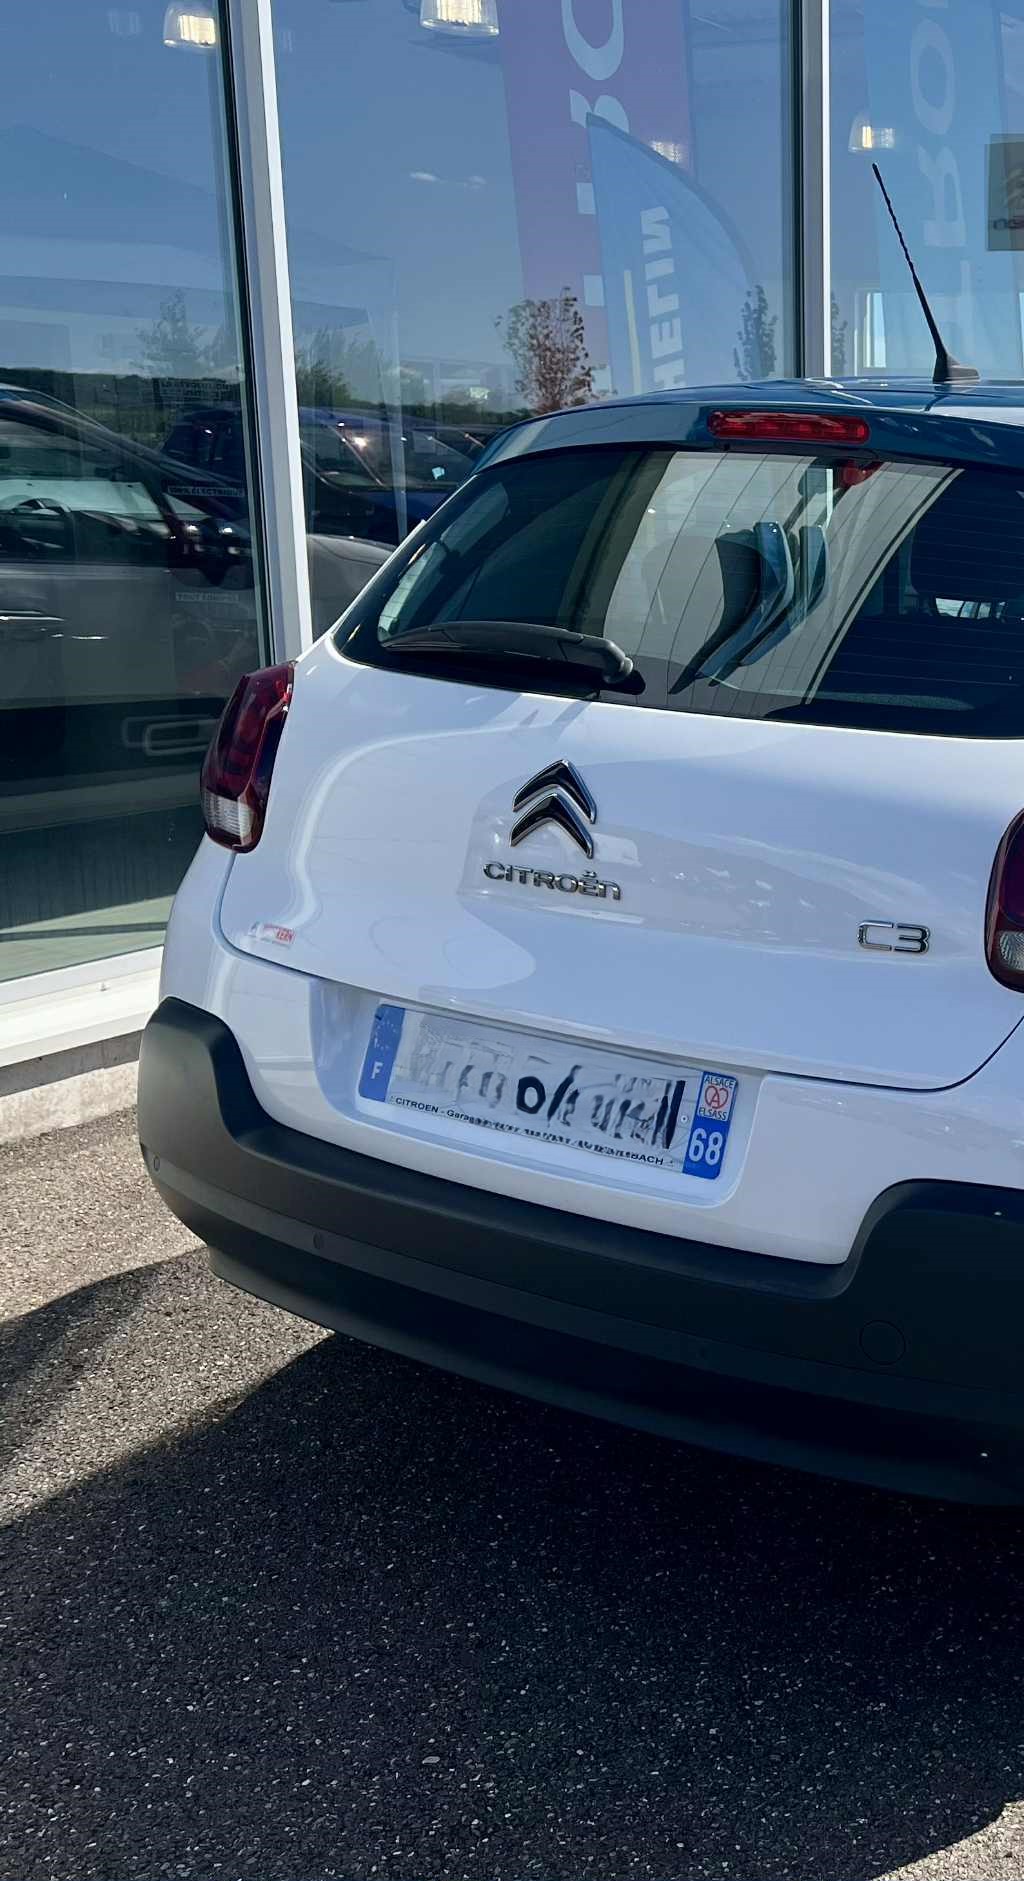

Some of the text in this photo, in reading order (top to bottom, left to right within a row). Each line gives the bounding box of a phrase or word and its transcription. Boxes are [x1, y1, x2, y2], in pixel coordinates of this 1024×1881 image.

[857, 920, 931, 954] C3
[371, 1061, 383, 1079] F
[704, 1075, 735, 1089] ALSACE
[395, 1096, 440, 1114] CITROEN
[698, 1106, 728, 1121] ELSASS
[688, 1127, 724, 1166] 68
